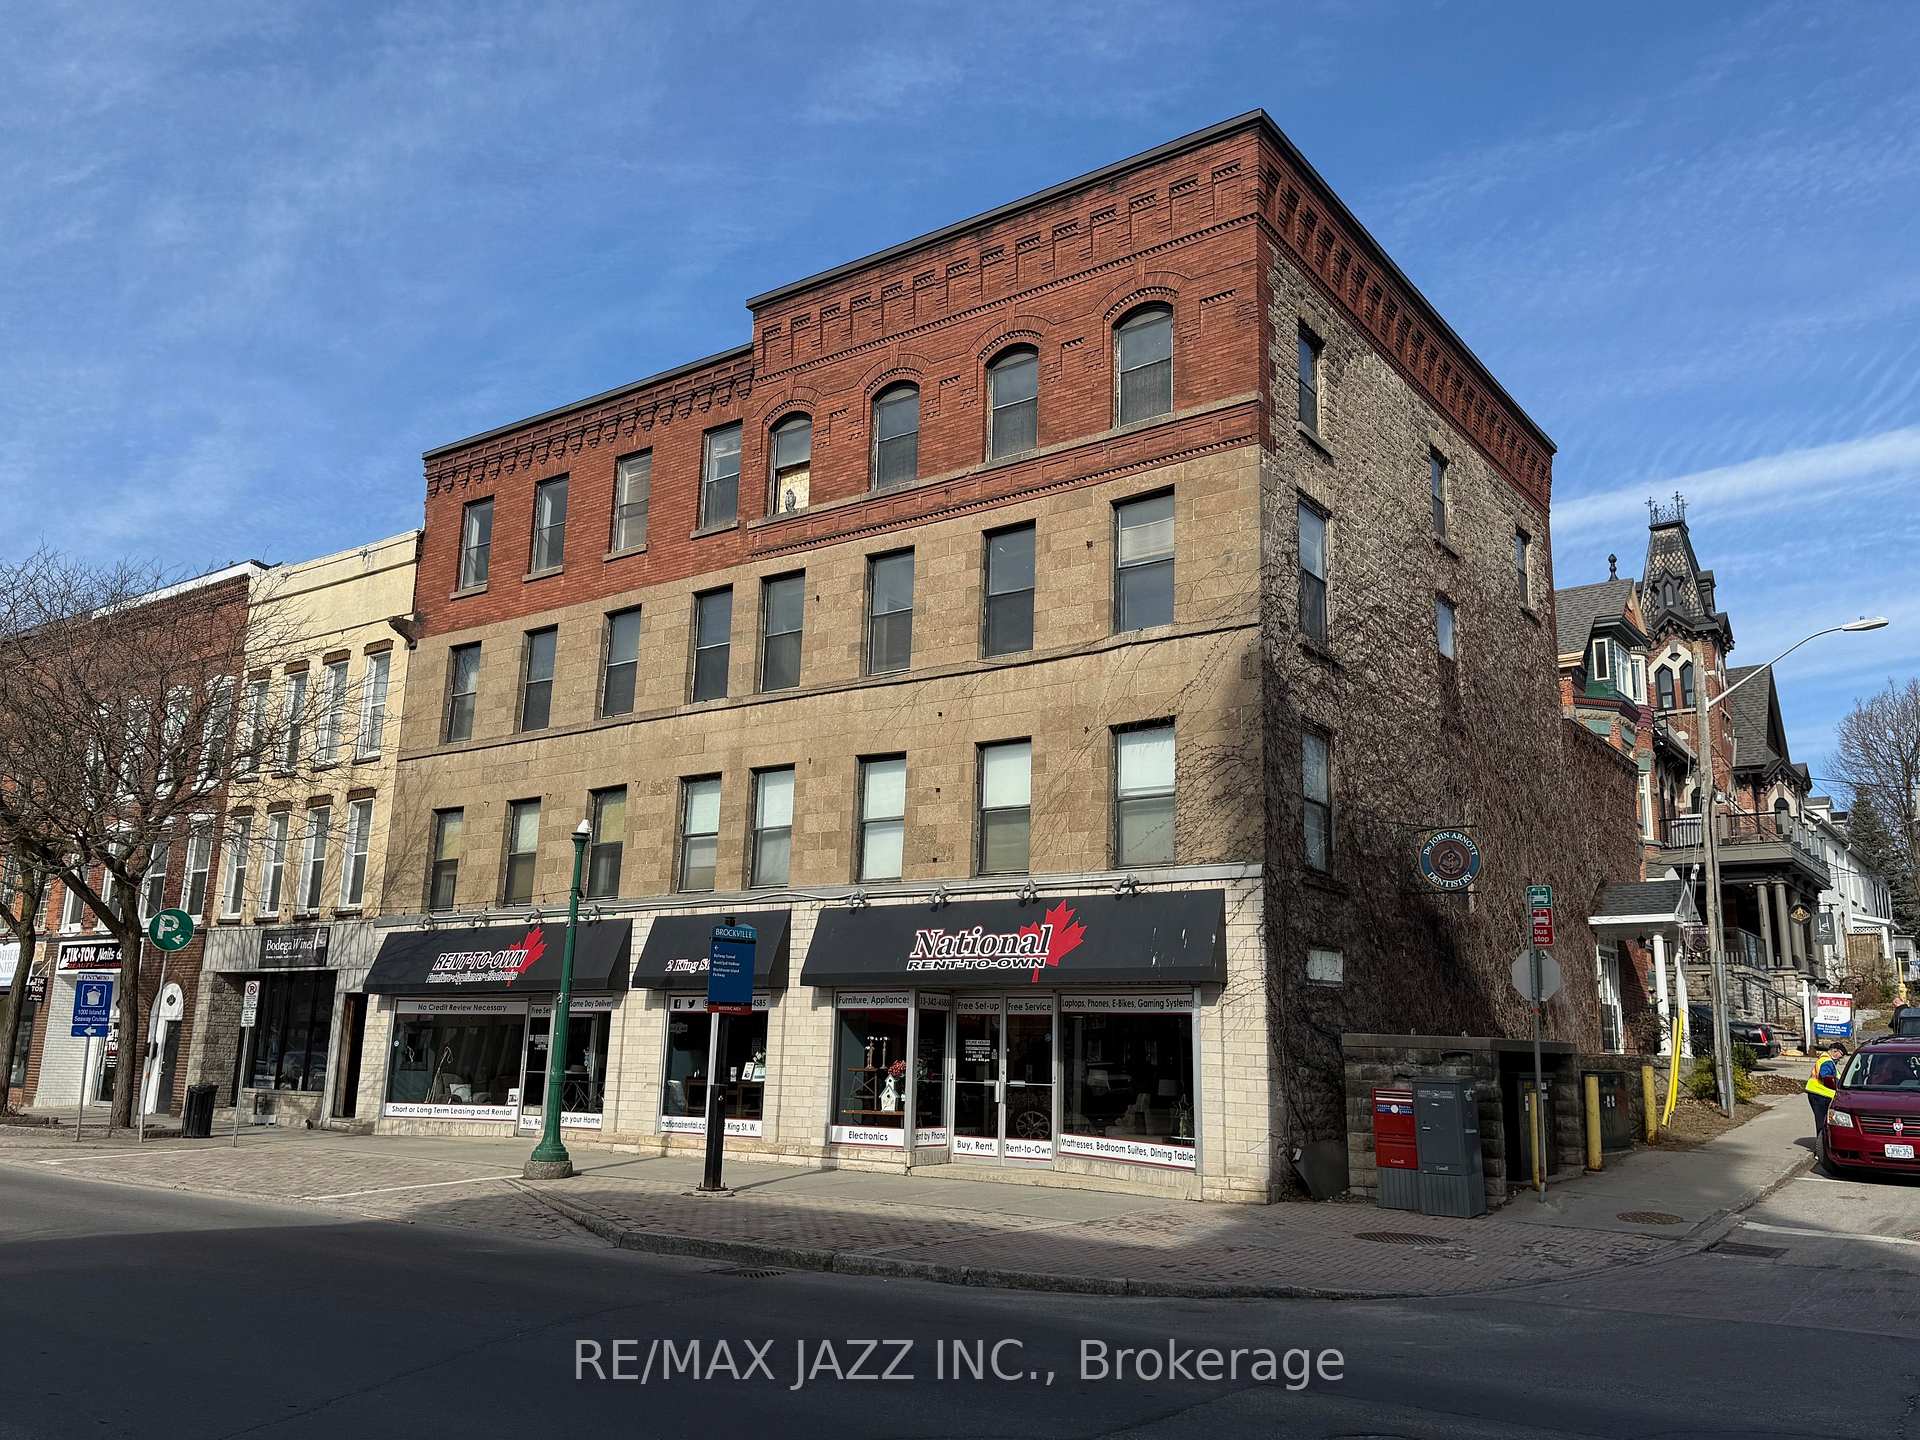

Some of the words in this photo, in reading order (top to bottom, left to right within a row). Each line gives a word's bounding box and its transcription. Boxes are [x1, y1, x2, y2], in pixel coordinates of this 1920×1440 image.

[1429, 831, 1450, 847] JOHN
[1451, 832, 1478, 856] ARNOTT
[1427, 871, 1473, 888] DENTISTRY
[715, 928, 753, 939] BROCKVILLE
[266, 937, 292, 954] Bodega
[293, 938, 313, 950] Wines
[910, 923, 1053, 958] National
[432, 950, 528, 971] RENT-TO-OWN
[665, 959, 674, 971] 2
[673, 958, 699, 974] King
[906, 957, 1047, 971] RENT-TO-OWN
[418, 1003, 426, 1011] No
[428, 1003, 448, 1011] Credit
[449, 1003, 471, 1011] Review
[471, 1003, 507, 1012] Necessary
[570, 999, 584, 1007] Same
[585, 999, 595, 1008] Day
[957, 1001, 975, 1009] Free
[975, 1002, 999, 1011] Set-up
[1008, 1002, 1023, 1010] Free
[1025, 1002, 1051, 1011] Service
[1137, 999, 1165, 1009] Gaming
[1165, 998, 1193, 1009] Systems
[392, 1105, 408, 1113] Short
[417, 1106, 432, 1114] Long
[433, 1106, 449, 1114] Term
[450, 1107, 475, 1116] Leasing
[476, 1107, 490, 1115] and
[491, 1108, 513, 1116] Rental
[569, 1116, 582, 1125] your
[583, 1116, 600, 1125] Home
[727, 1122, 740, 1132] King
[848, 1130, 888, 1141] Electronics
[924, 1132, 931, 1142] by
[931, 1131, 946, 1141] Phone
[1006, 1143, 1052, 1154] Rent-to-Own
[1096, 1141, 1126, 1154] Bedroom
[1127, 1145, 1149, 1157] Suites,
[1150, 1147, 1173, 1161] Dining
[1174, 1150, 1197, 1162] Tables
